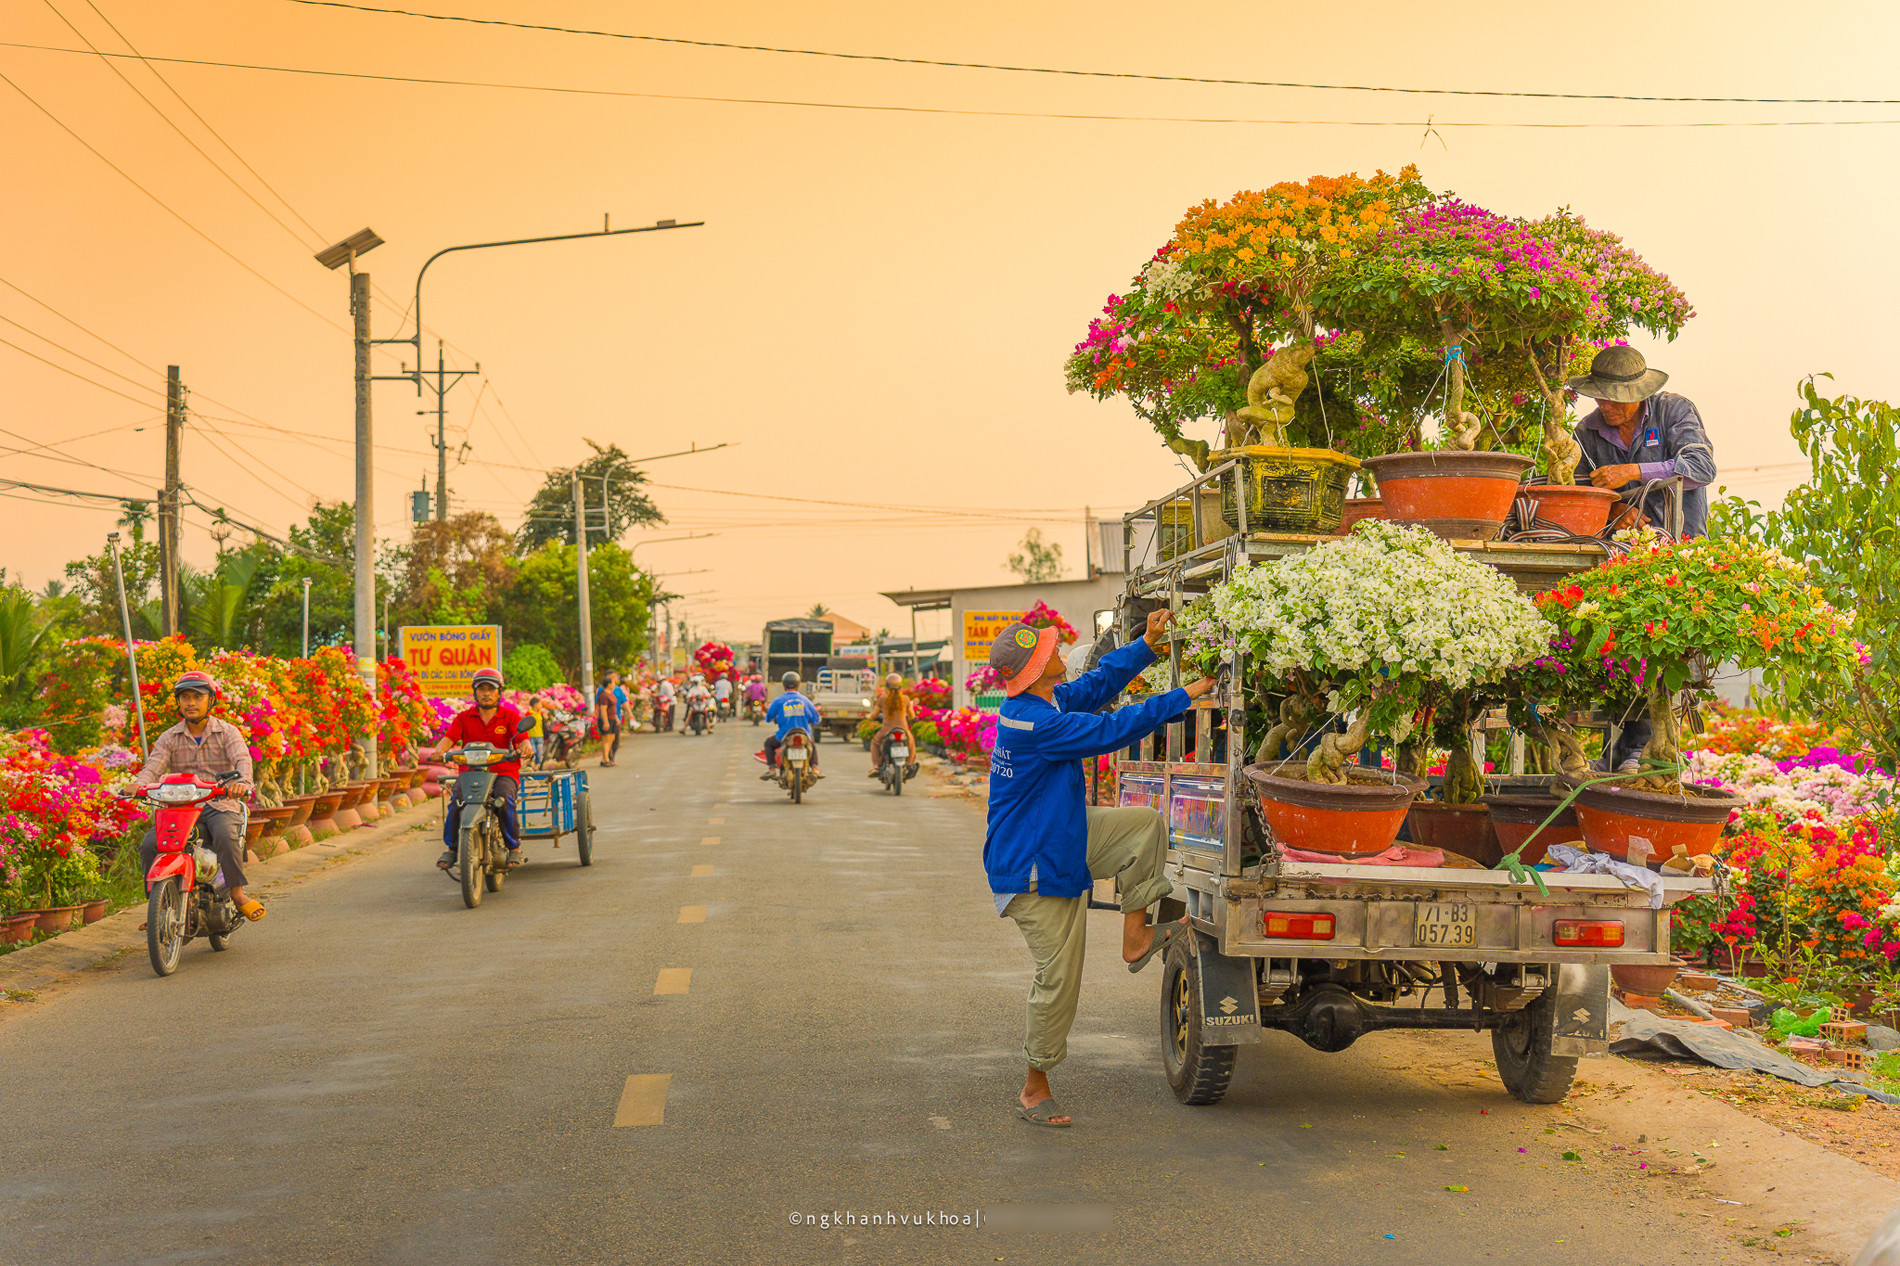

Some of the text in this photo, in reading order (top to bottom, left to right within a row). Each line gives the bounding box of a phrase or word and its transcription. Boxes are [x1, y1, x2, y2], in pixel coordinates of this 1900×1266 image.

[440, 630, 466, 641] BÔNG
[469, 628, 491, 641] GIẤY
[409, 643, 491, 666] TƯ QUÂN
[1419, 924, 1473, 944] 057.39
[1206, 1014, 1255, 1026] SUZUKI
